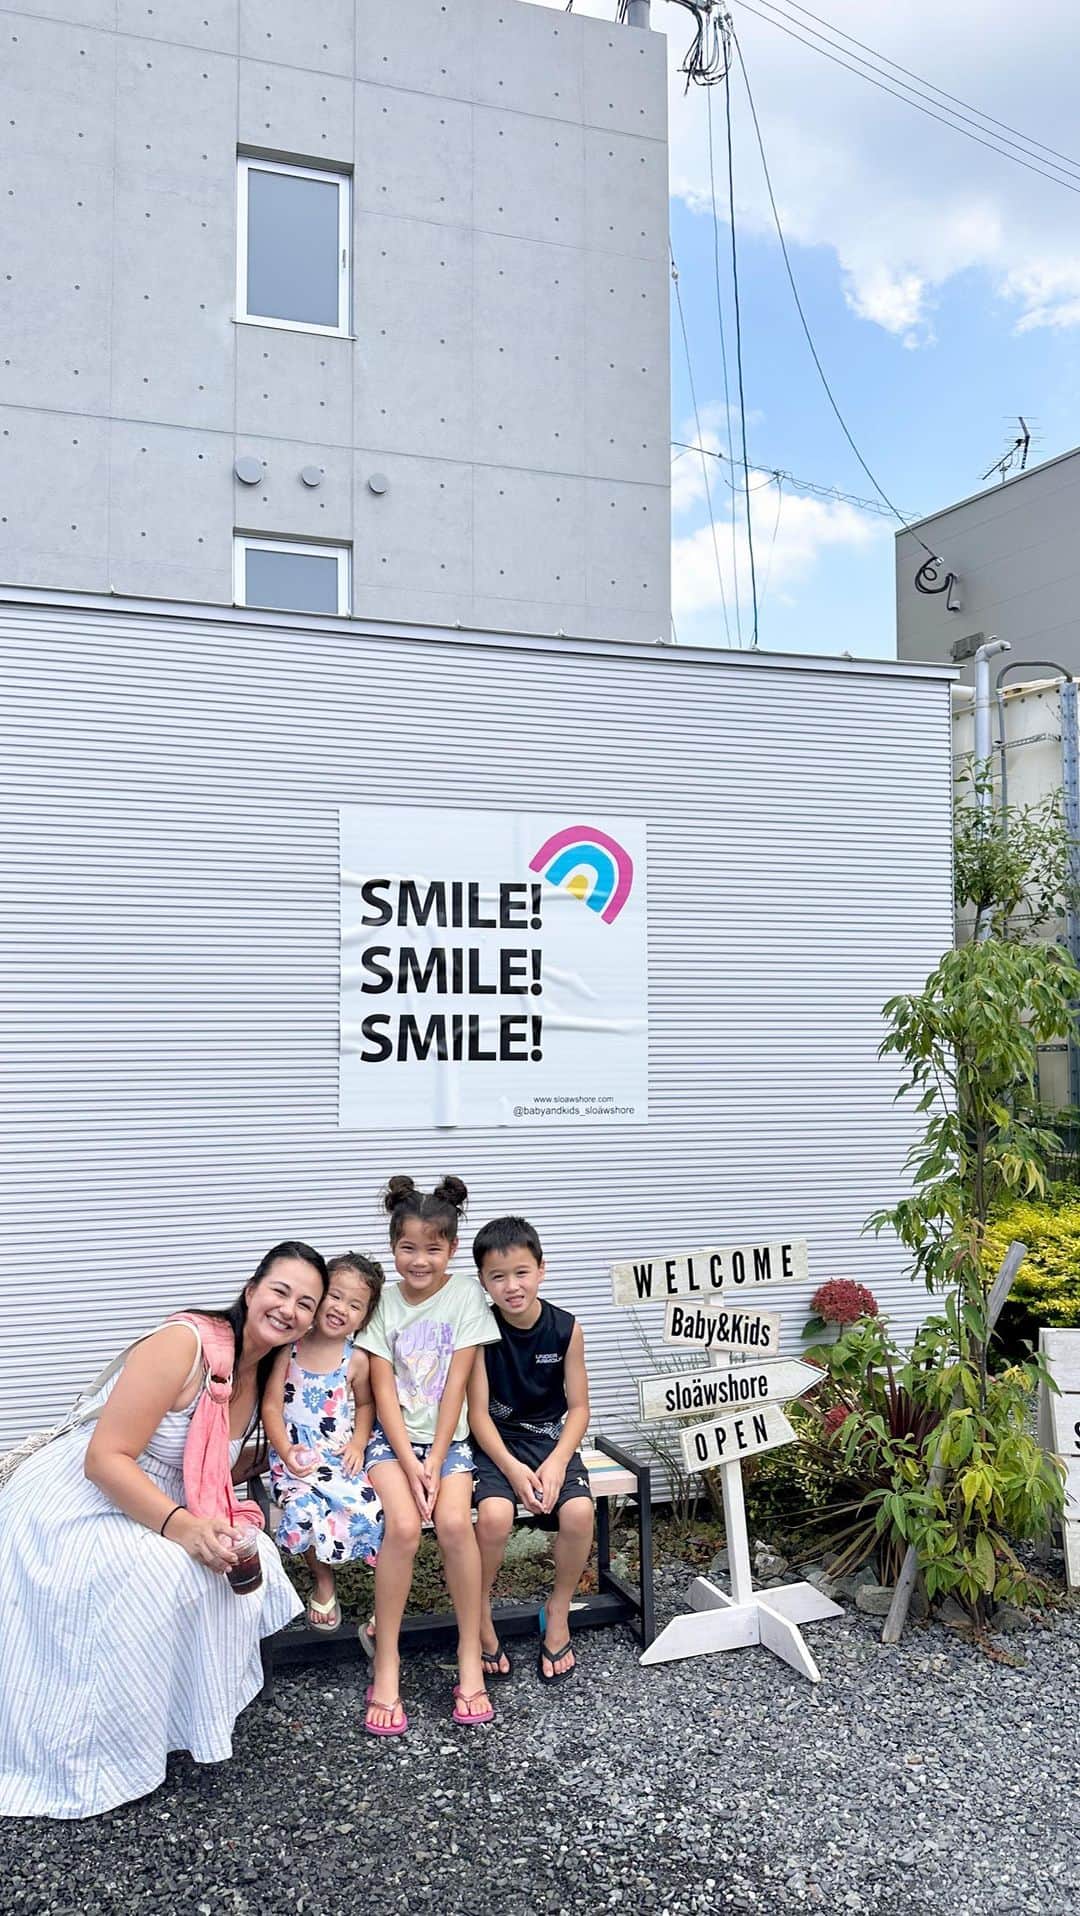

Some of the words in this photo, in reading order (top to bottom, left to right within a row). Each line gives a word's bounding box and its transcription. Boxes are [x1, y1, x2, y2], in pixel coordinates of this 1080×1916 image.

[360, 879, 542, 930] SMILE!
[360, 946, 542, 996] SMILE!
[360, 1013, 543, 1063] SMILE!
[633, 1244, 793, 1299] WELCOME
[671, 1307, 771, 1348] Baby&Kids
[665, 1373, 768, 1412] sloäwshore
[694, 1414, 769, 1462] OPEN
